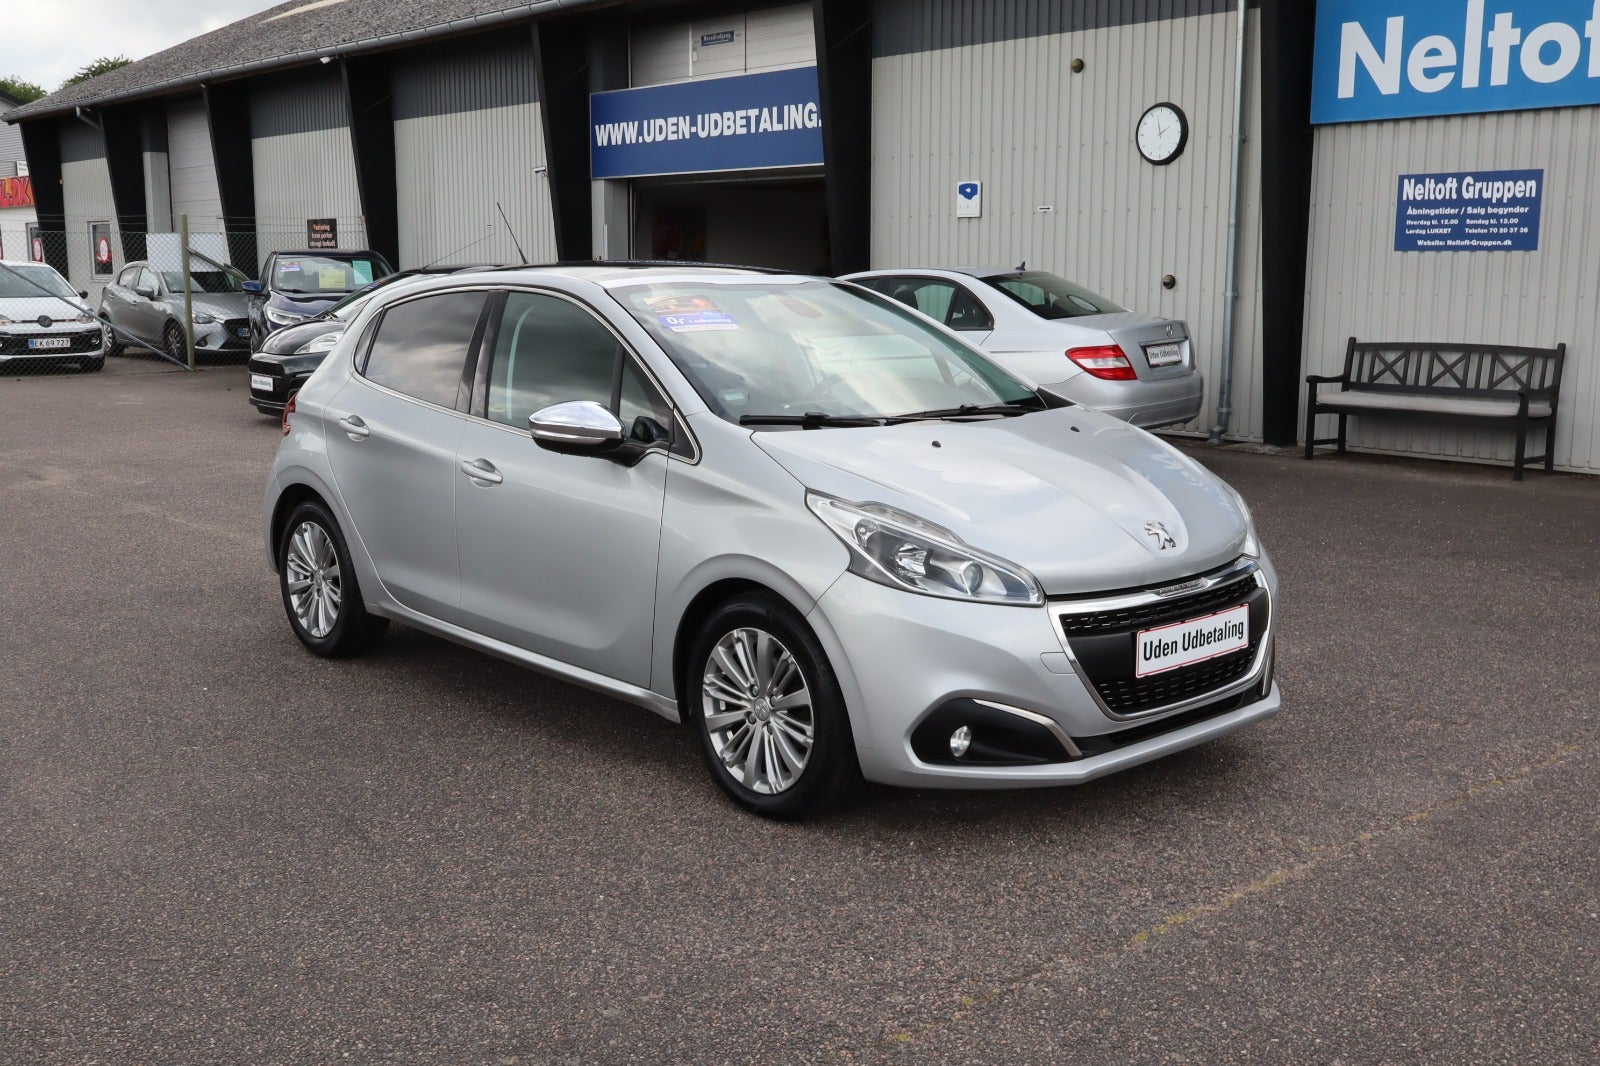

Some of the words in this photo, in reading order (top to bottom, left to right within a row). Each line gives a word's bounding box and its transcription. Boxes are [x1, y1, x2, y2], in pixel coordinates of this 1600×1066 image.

[1403, 177, 1458, 201] Neltoft
[1462, 176, 1537, 203] Gruppen
[1407, 206, 1459, 215] Åbningstider
[1466, 206, 1486, 215] Salg
[1487, 206, 1529, 214] begynder
[1143, 638, 1178, 661] Uden
[1182, 620, 1244, 652] Udbetaling
